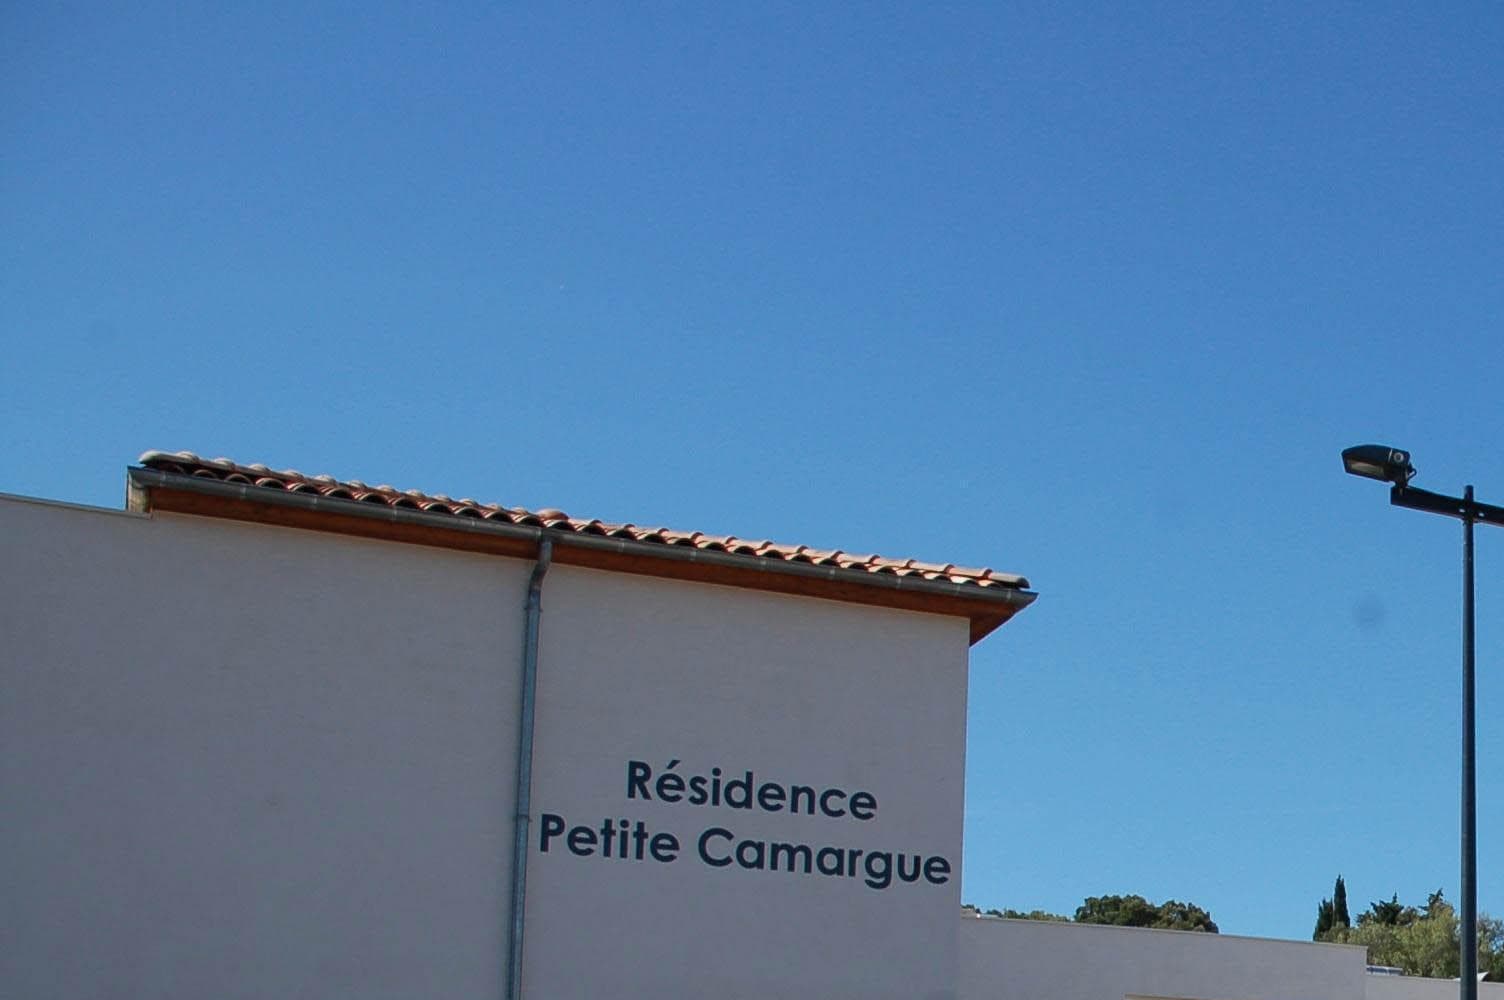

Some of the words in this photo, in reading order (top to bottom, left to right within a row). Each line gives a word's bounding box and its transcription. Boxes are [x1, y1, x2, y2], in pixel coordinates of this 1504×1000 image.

[627, 760, 877, 820] Résidence
[540, 814, 680, 862] Petite
[698, 828, 951, 889] Camargue
